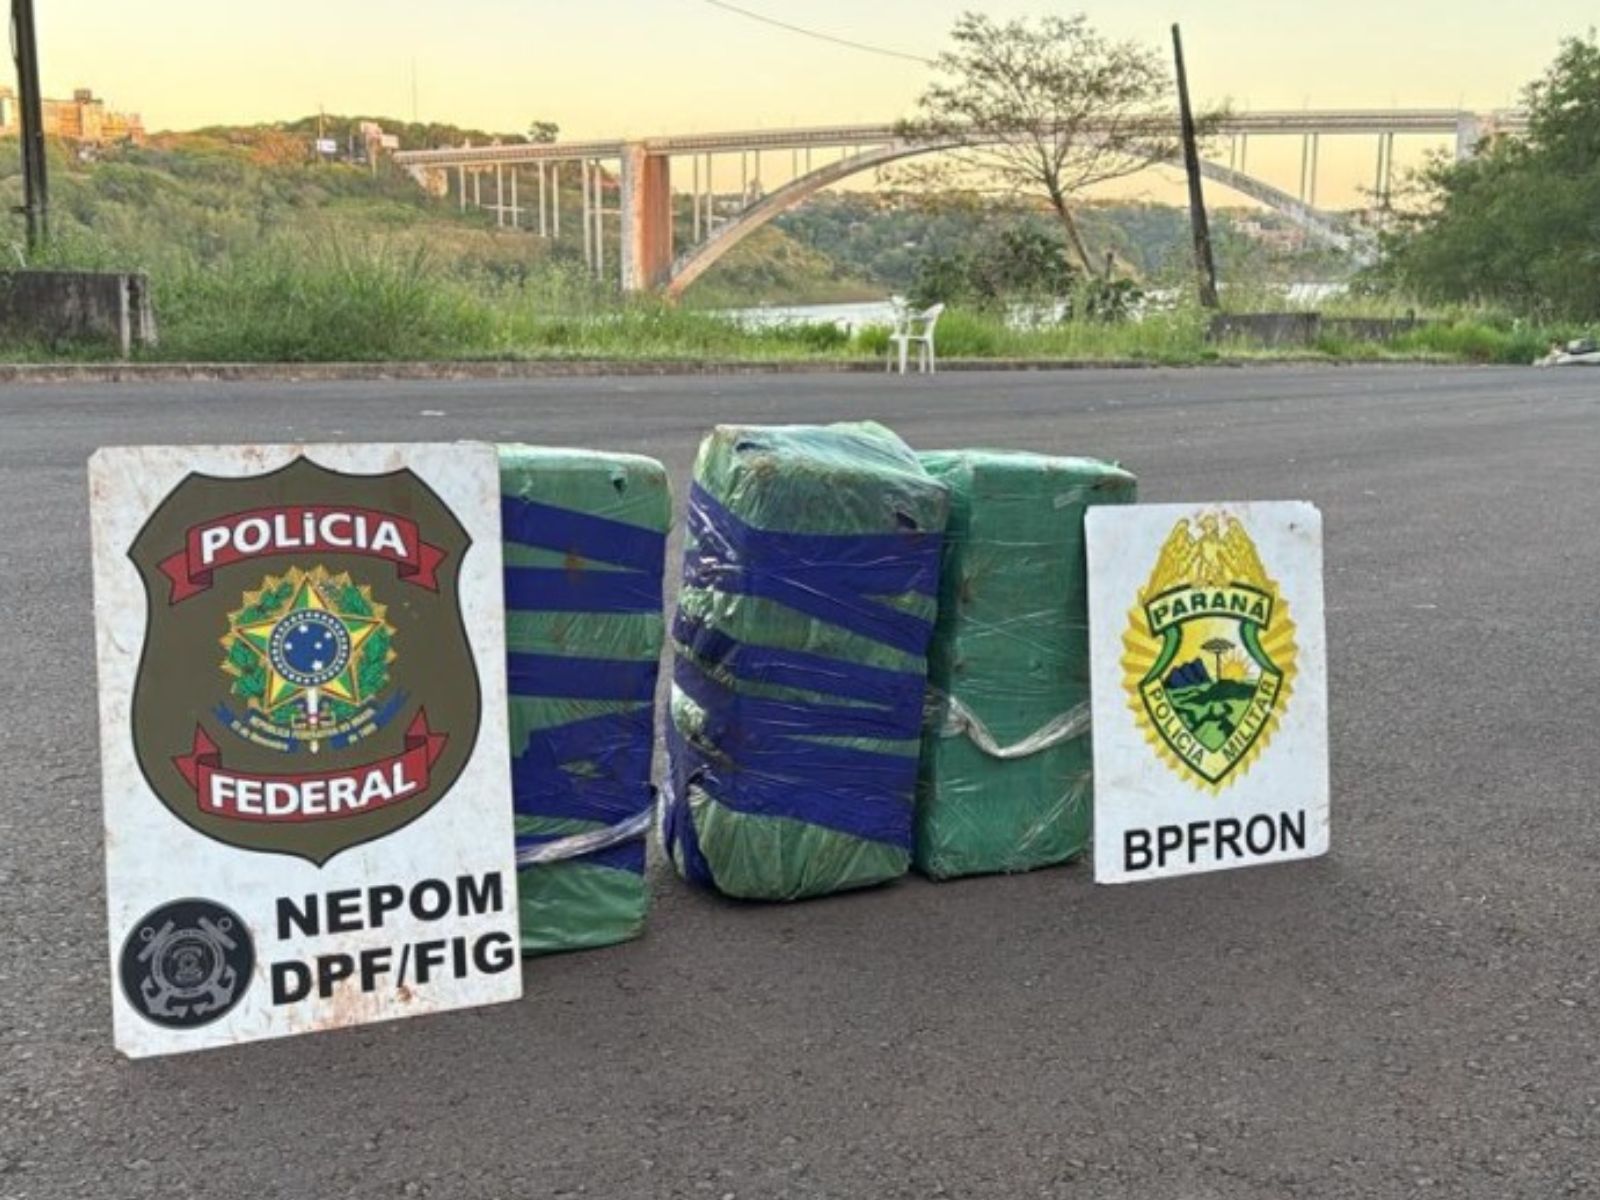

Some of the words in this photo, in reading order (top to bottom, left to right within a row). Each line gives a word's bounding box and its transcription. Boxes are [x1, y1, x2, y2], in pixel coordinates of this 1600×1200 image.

[1222, 679, 1275, 761] MILITAR
[209, 762, 417, 815] FEDERAL
[1123, 810, 1306, 872] BPFRON
[276, 871, 504, 941] NEPOM
[271, 930, 514, 1007] DPF/FIG
